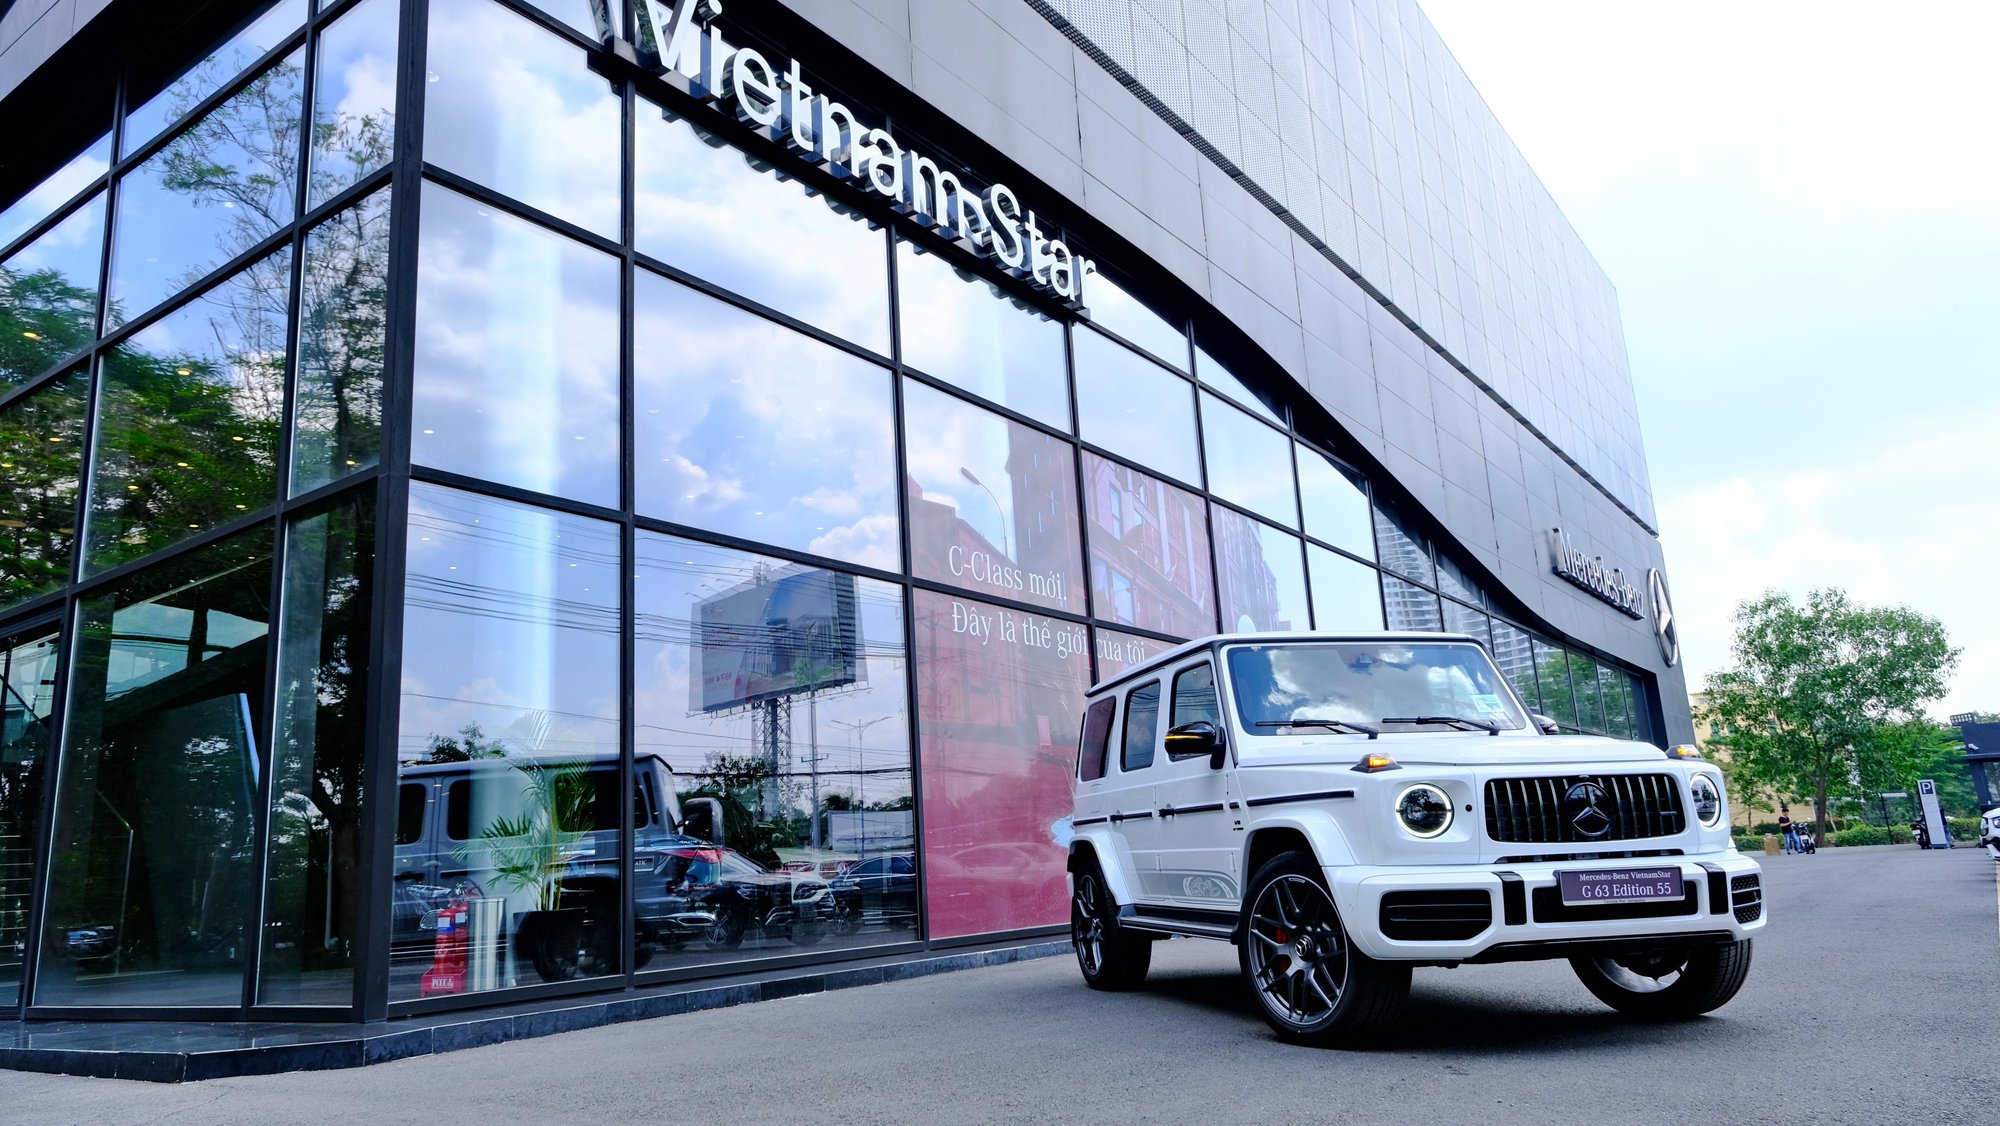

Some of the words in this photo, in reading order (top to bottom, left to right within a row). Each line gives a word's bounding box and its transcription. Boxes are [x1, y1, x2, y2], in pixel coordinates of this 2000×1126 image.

[644, 0, 1097, 309] VietnamStar
[949, 545, 1023, 591] C-Class
[951, 601, 992, 646] Đây
[998, 611, 1017, 644] là
[1022, 617, 1051, 649] thế
[1056, 625, 1089, 659] giới
[1095, 631, 1123, 663] của
[1126, 640, 1146, 665] tôi
[1921, 782, 1930, 794] P
[1579, 872, 1630, 882] Mercedes-Benz
[1630, 870, 1672, 880] VietnamStar
[1582, 885, 1592, 898] G
[1594, 884, 1610, 898] 63
[1613, 883, 1654, 897] Edition
[1657, 882, 1672, 895] 55
